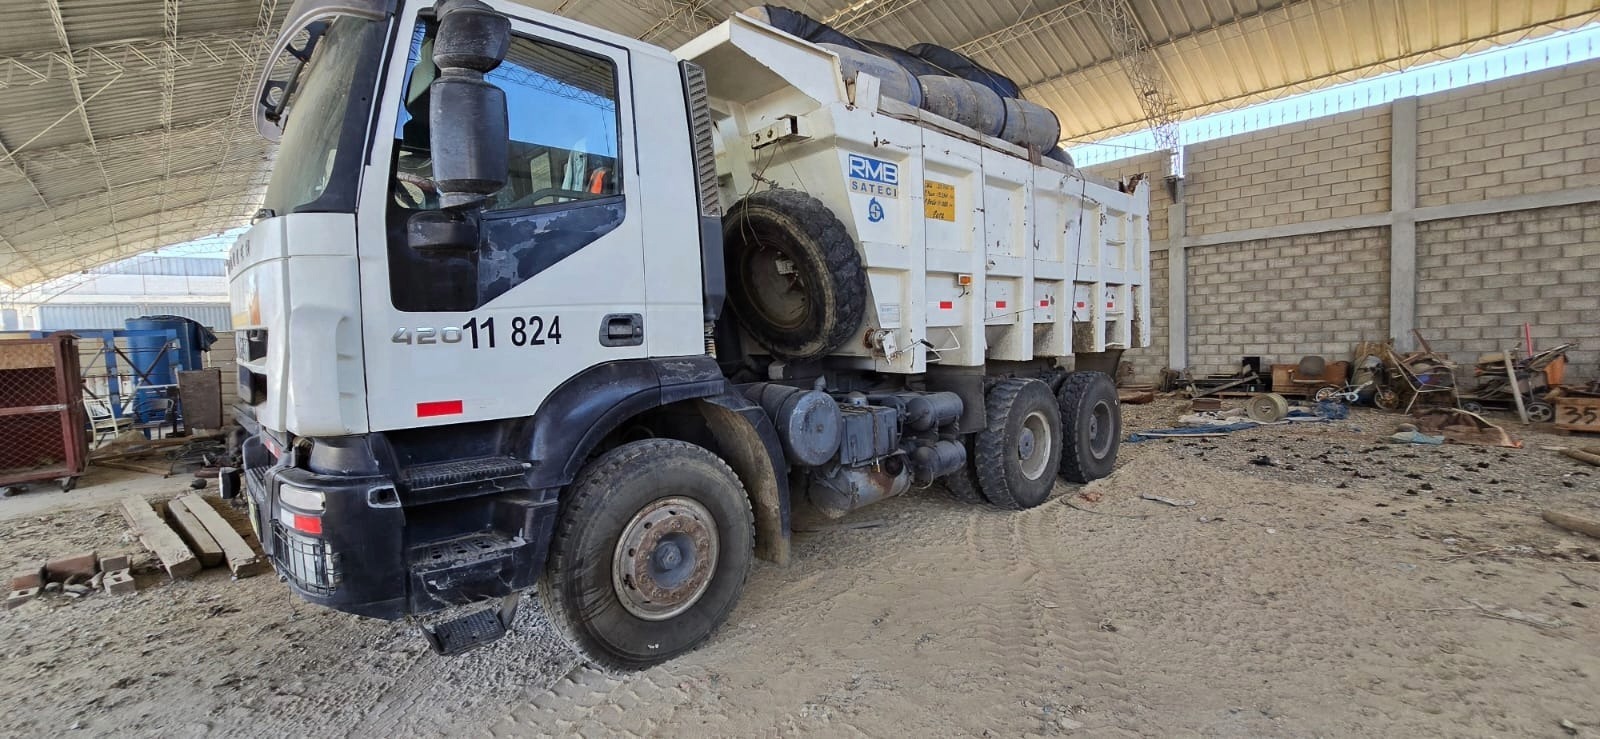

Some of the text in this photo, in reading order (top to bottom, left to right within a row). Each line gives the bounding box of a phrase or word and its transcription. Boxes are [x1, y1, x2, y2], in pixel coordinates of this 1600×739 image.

[849, 155, 898, 184] RMB
[852, 181, 897, 197] SATECI
[391, 327, 462, 345] 420
[463, 315, 562, 349] 11 824
[1563, 406, 1597, 425] 35
